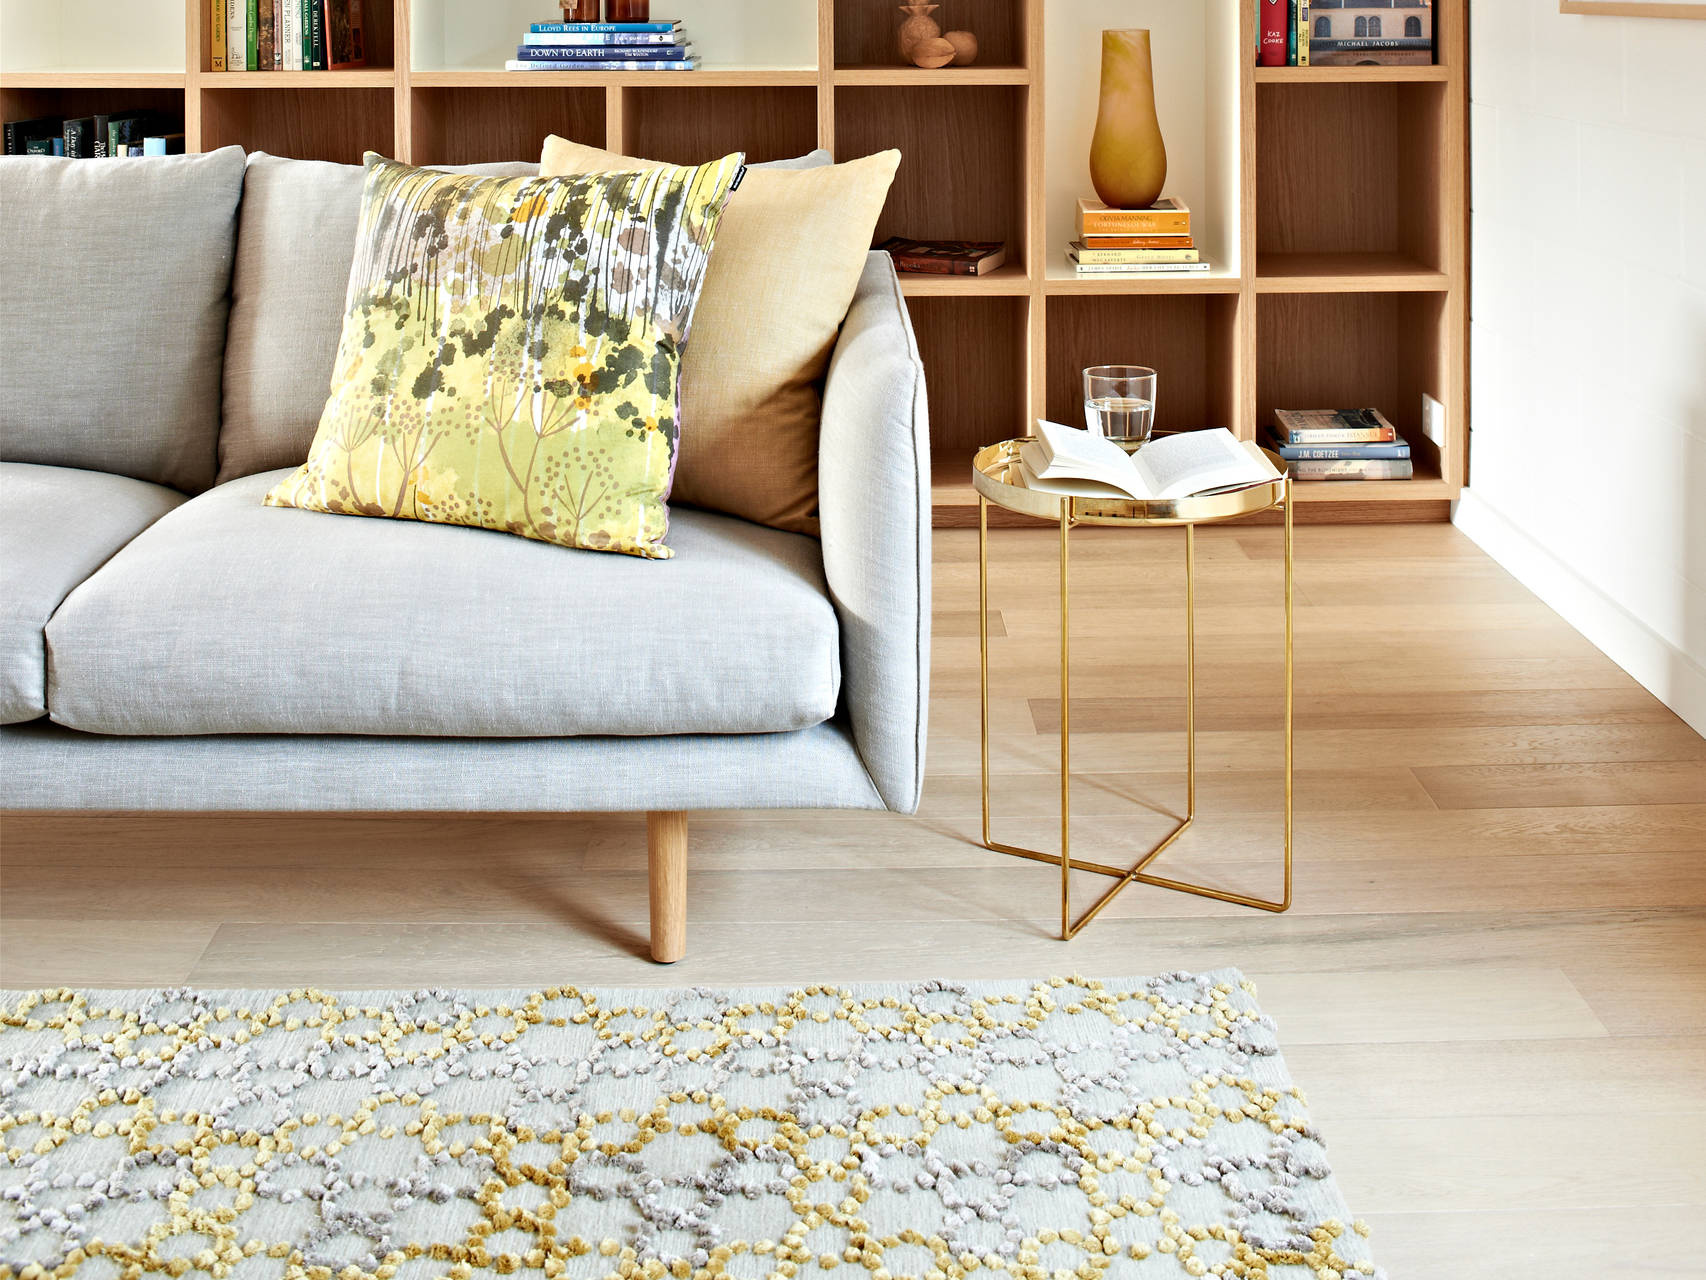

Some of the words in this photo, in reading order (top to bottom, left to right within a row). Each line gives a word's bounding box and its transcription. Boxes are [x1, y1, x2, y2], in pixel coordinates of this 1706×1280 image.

[591, 24, 616, 32] EUROPE
[530, 48, 560, 57] DOWN
[561, 48, 573, 57] TO
[576, 48, 605, 57] EARTH
[1313, 450, 1339, 458] COETZEE
